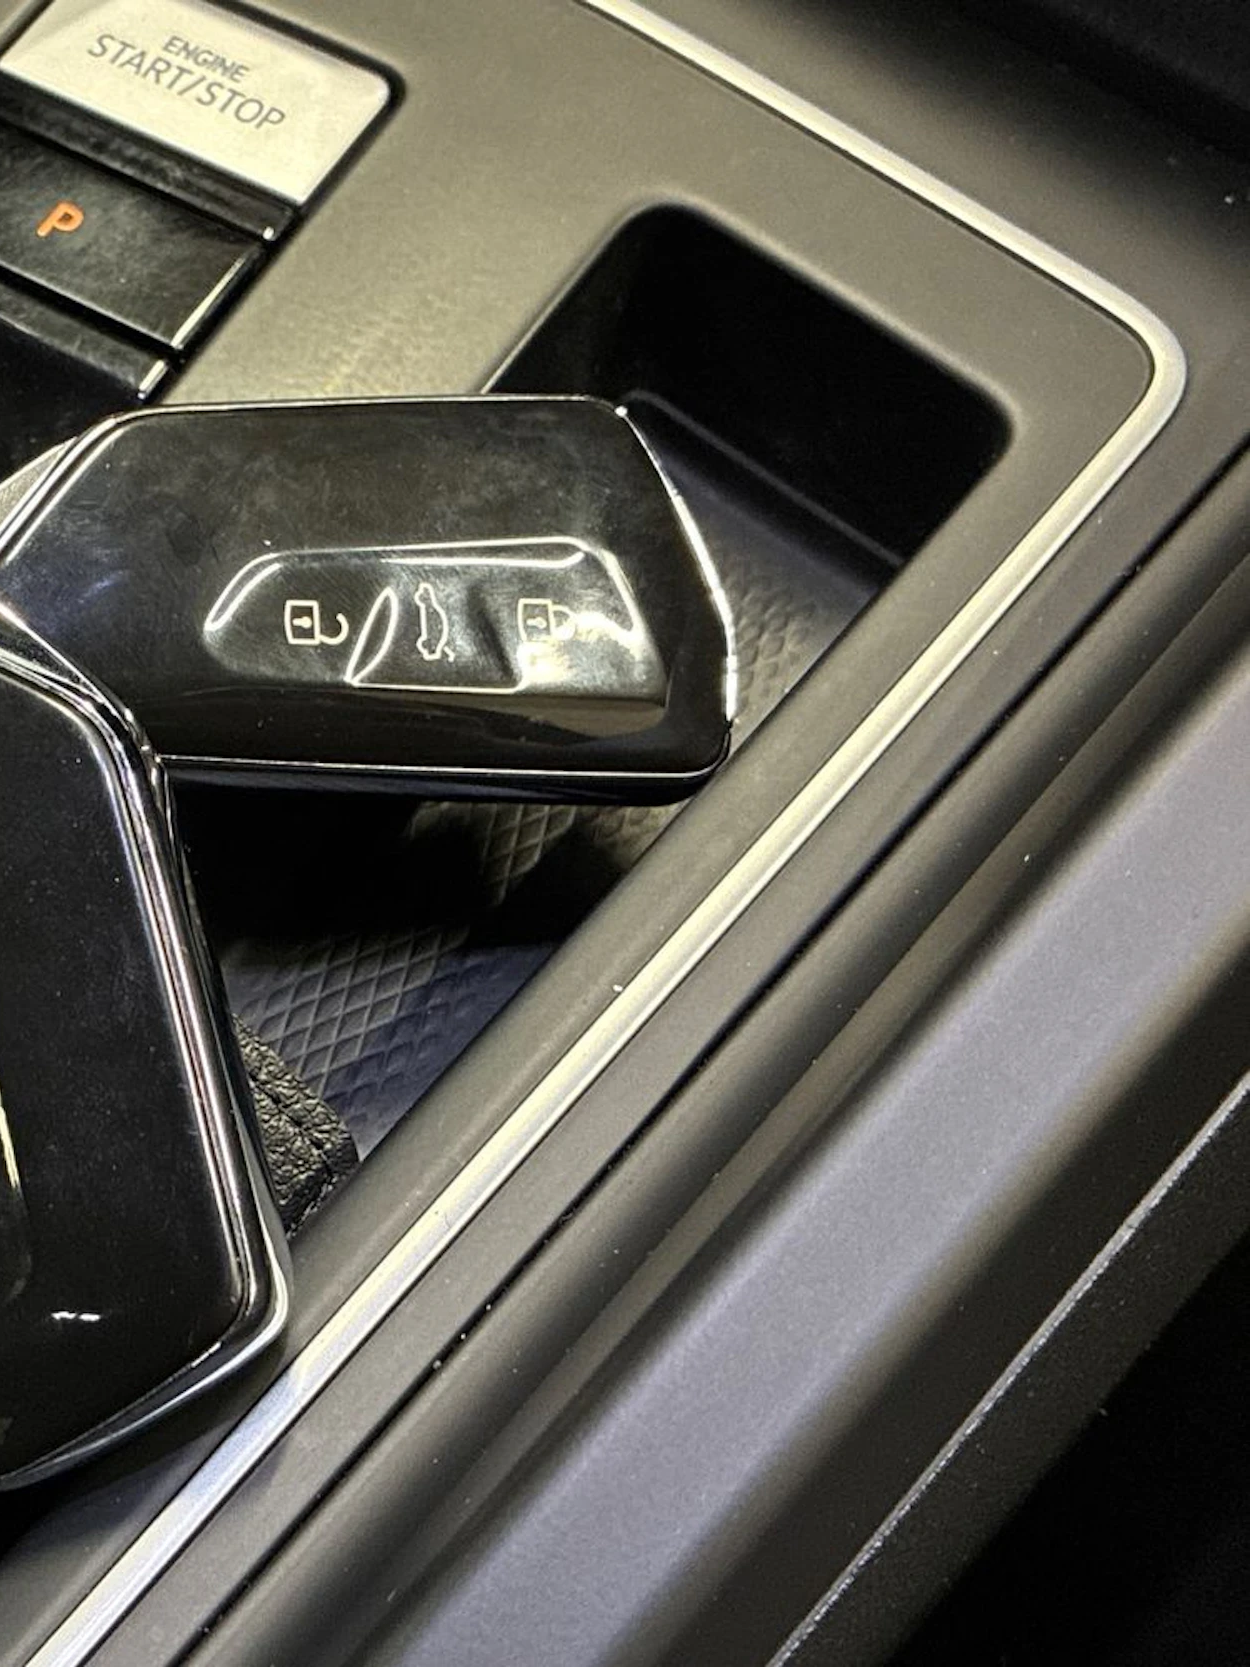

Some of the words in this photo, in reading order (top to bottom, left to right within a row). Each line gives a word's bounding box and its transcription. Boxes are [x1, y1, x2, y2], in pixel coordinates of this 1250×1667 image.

[87, 33, 286, 129] START/STOP
[162, 35, 250, 83] ENGINE
[36, 200, 85, 238] P
